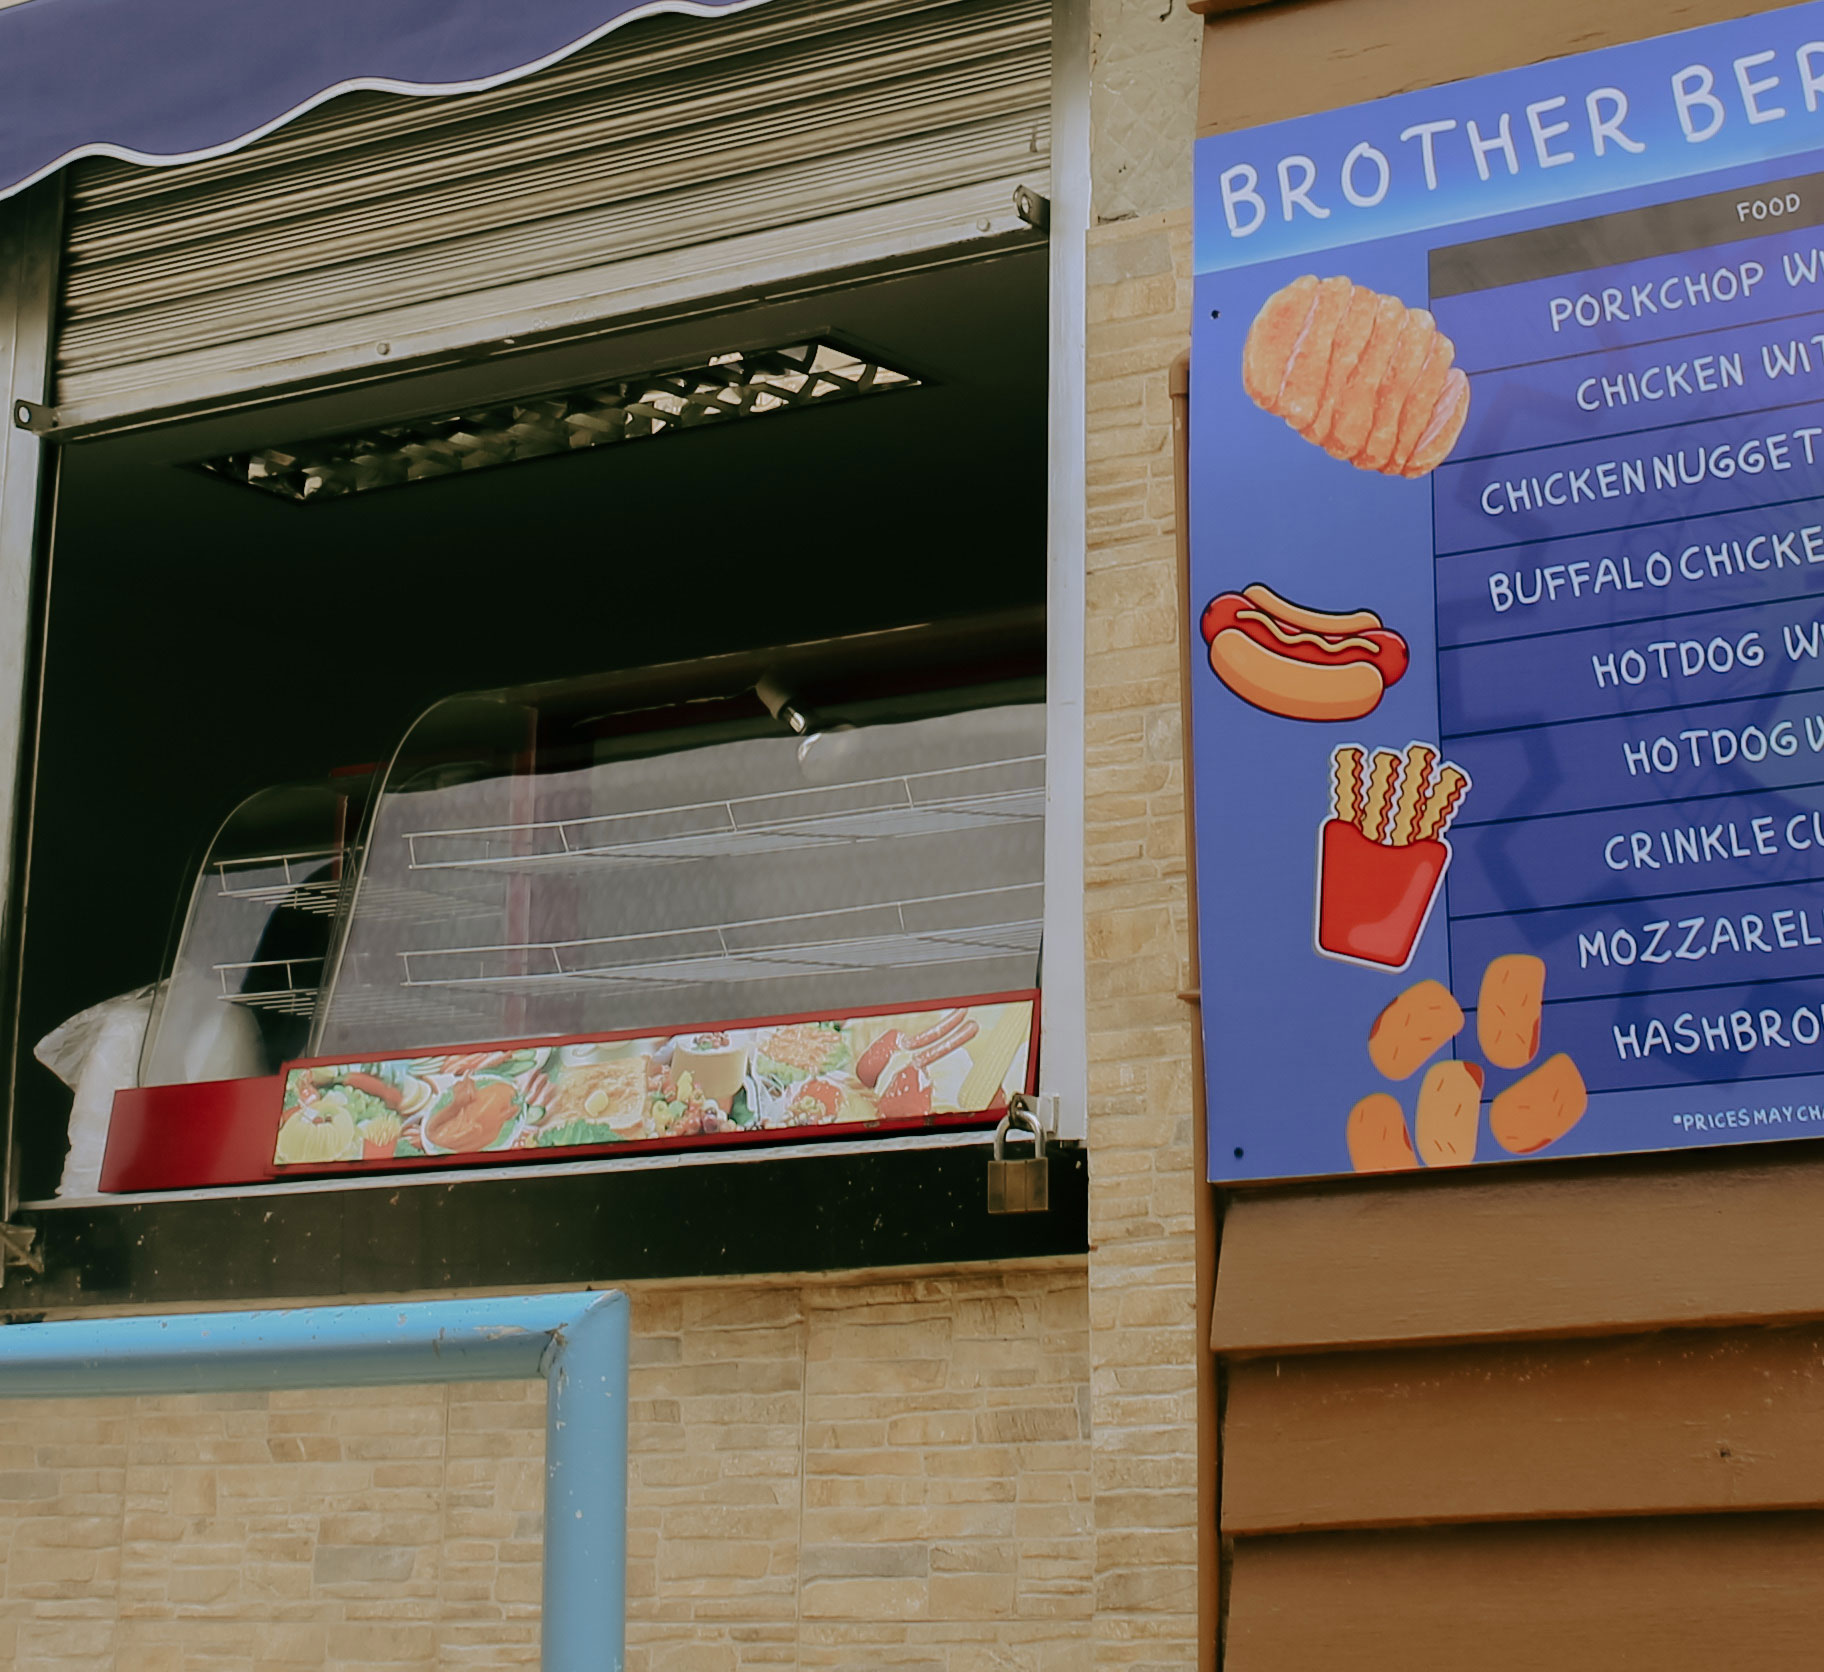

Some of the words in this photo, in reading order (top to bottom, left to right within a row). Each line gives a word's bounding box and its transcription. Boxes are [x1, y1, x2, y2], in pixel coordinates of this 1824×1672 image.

[1220, 87, 1645, 238] BROTHER
[1736, 192, 1801, 223] FOOD
[1549, 261, 1764, 332] PORKCHOP
[1575, 352, 1744, 412] CHICKEN
[1591, 632, 1765, 689] HOTDOG
[1754, 1107, 1792, 1124] MAY
